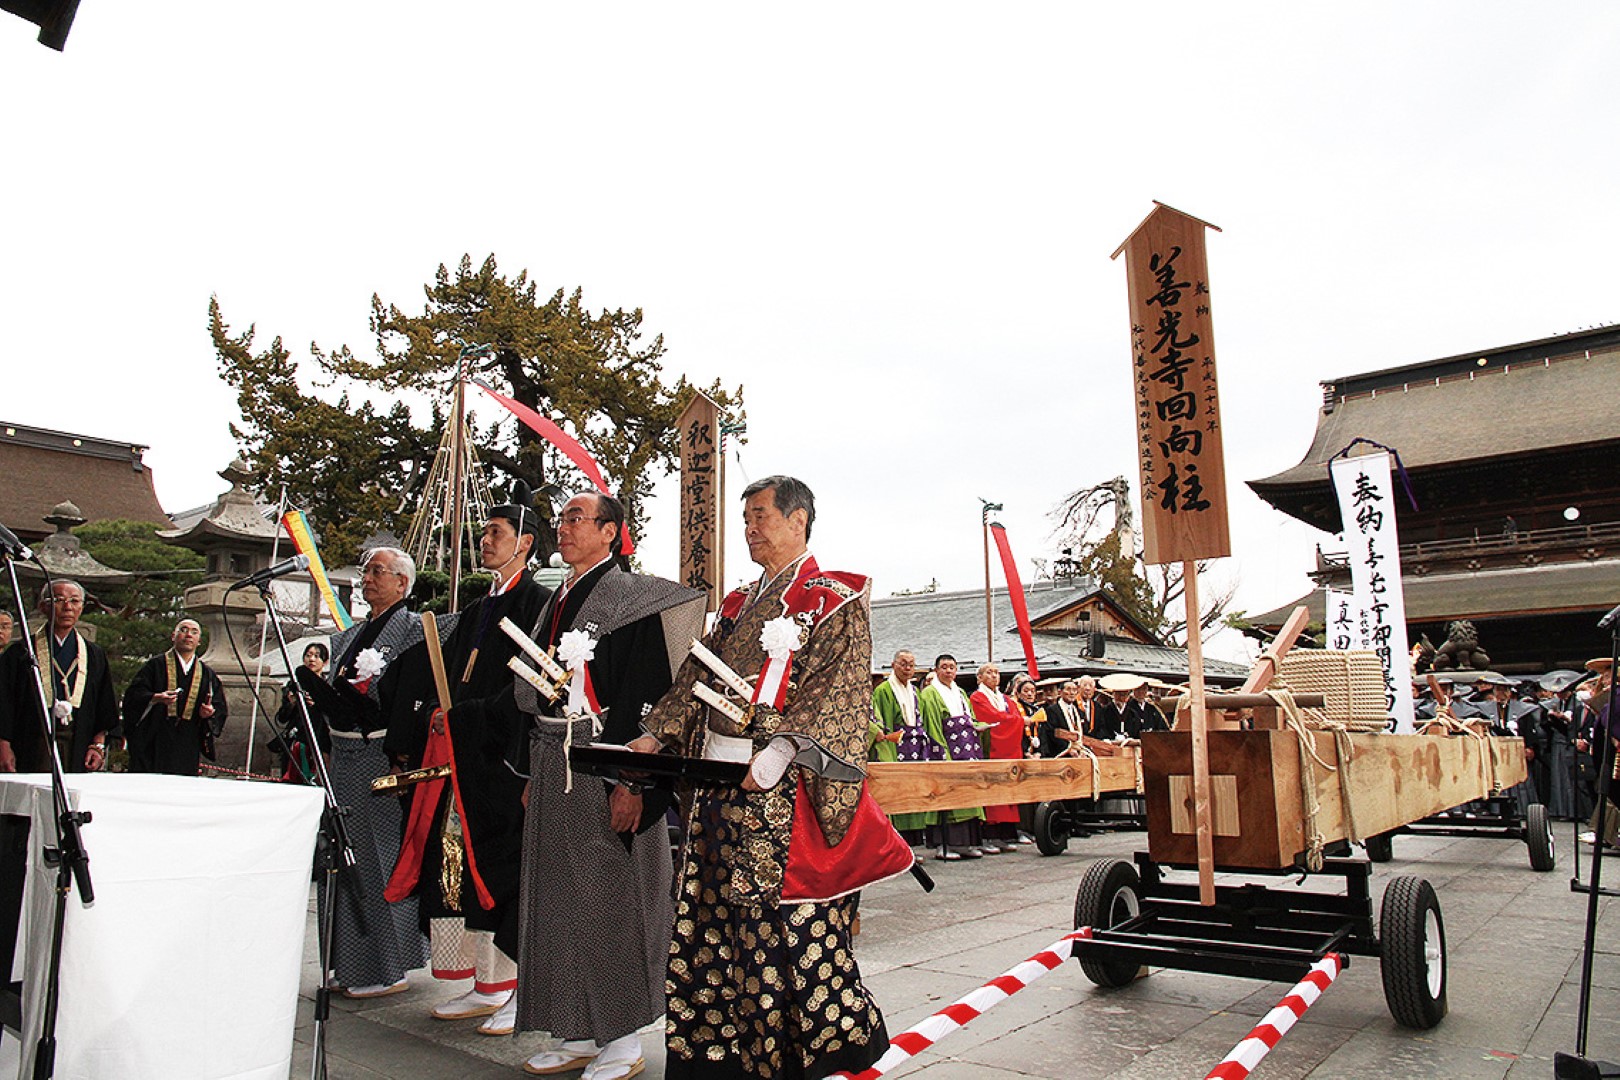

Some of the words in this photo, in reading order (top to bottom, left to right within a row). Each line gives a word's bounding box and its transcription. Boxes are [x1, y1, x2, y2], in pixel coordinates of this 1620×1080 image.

[1195, 281, 1209, 318] 奉納
[1146, 246, 1211, 514] 善光寺回向柱
